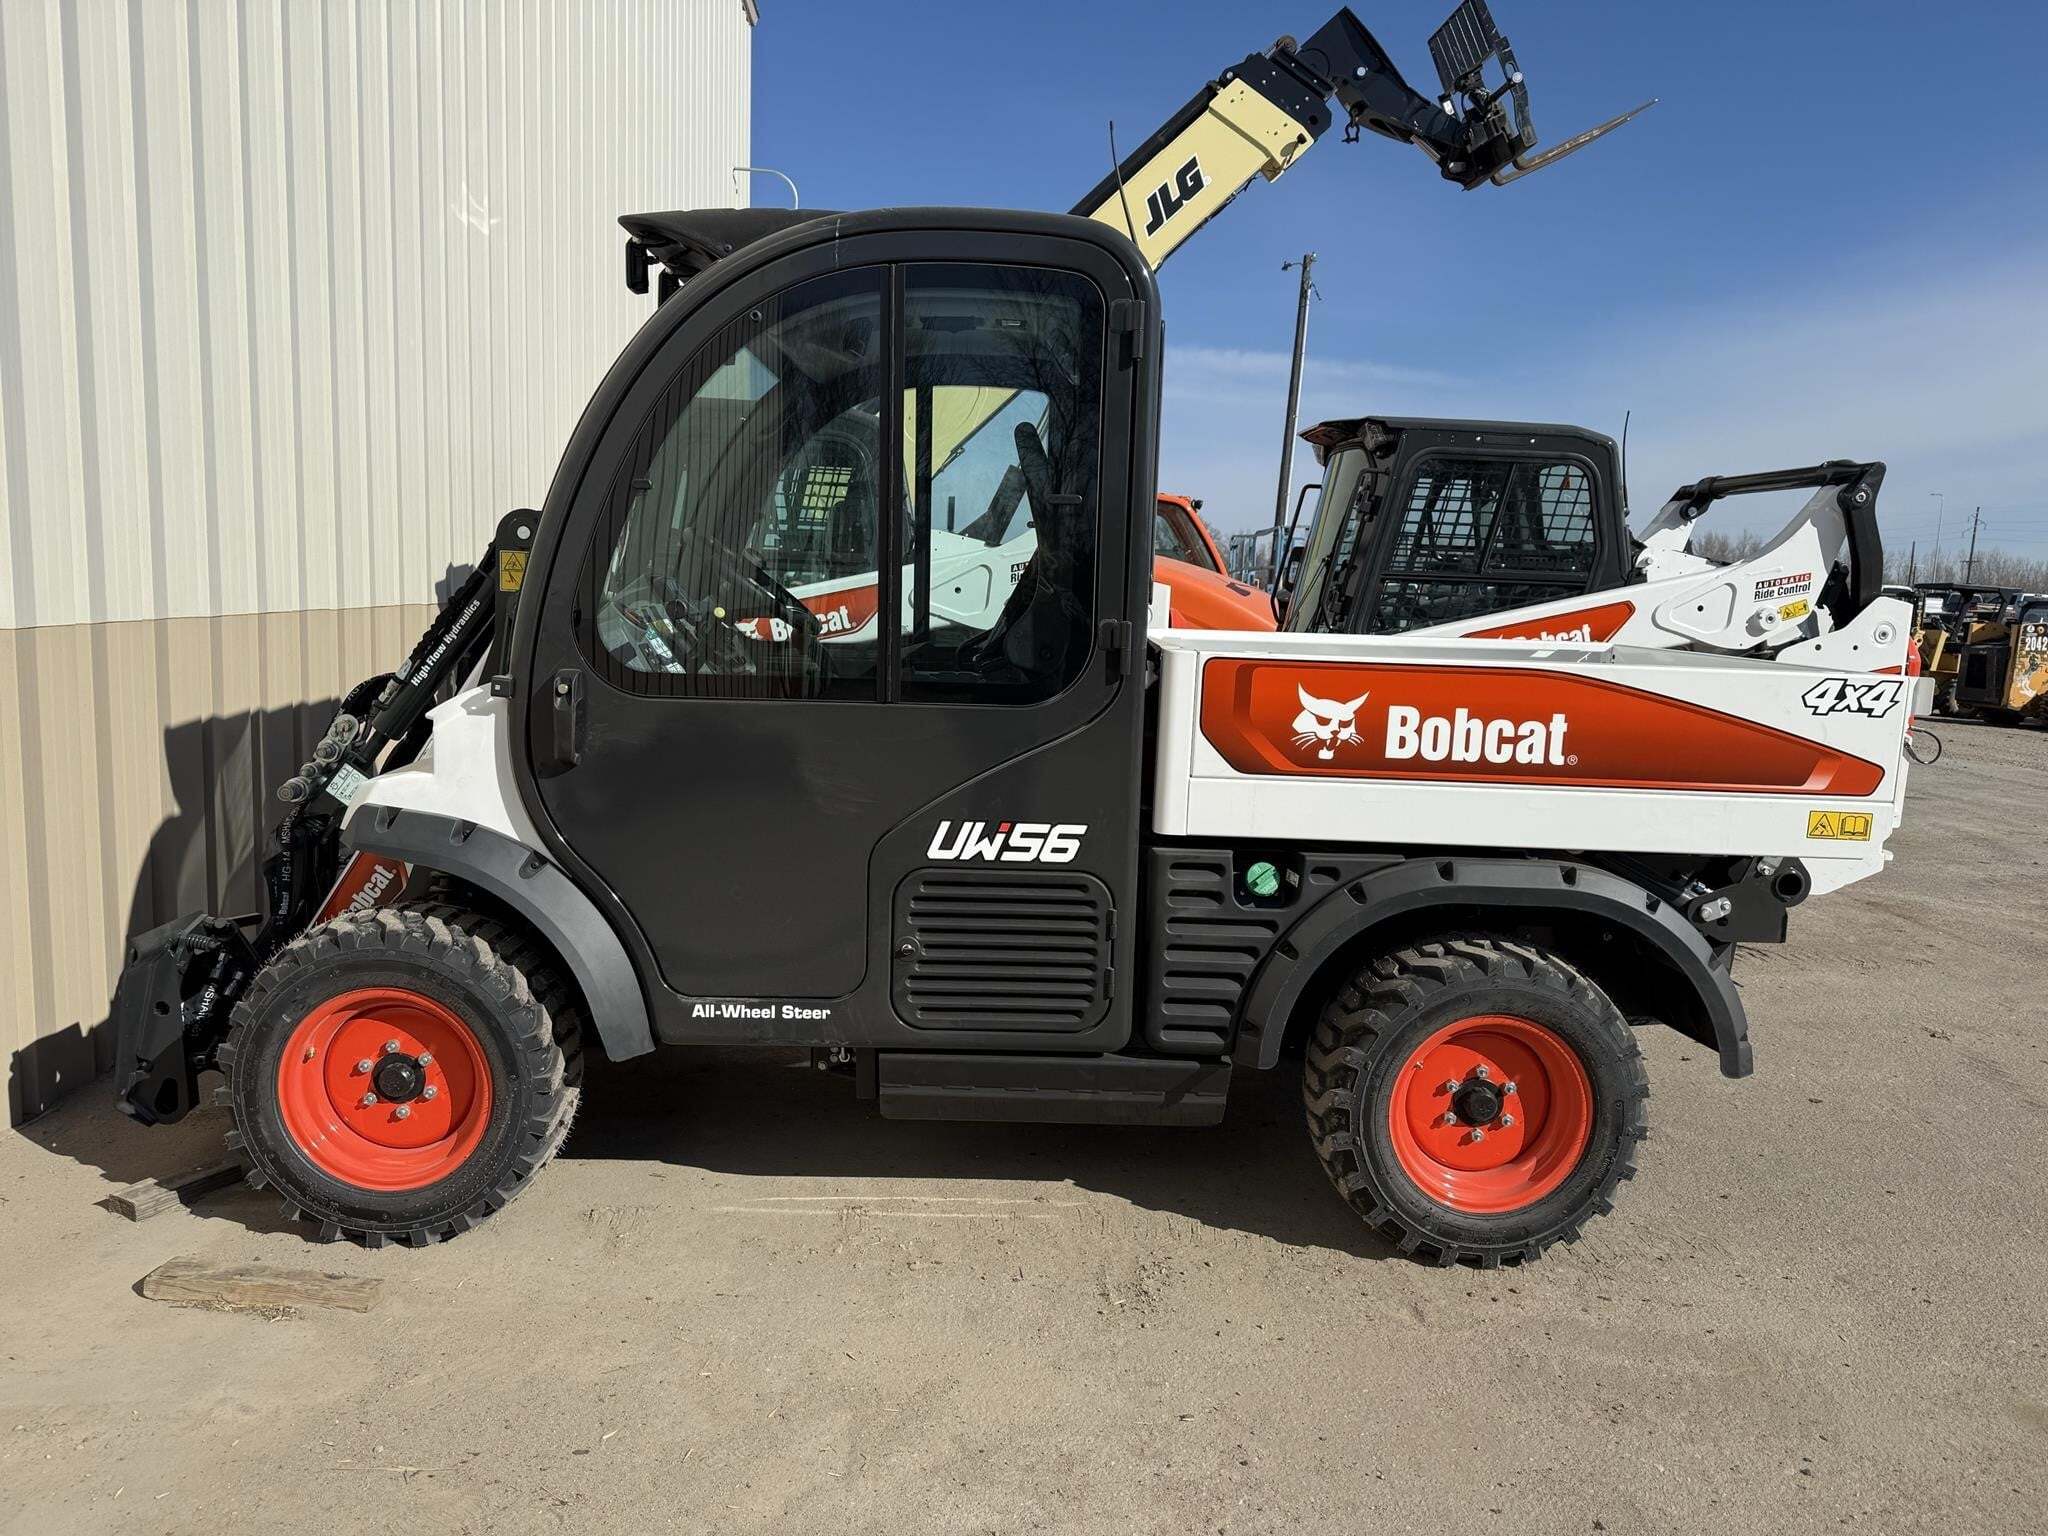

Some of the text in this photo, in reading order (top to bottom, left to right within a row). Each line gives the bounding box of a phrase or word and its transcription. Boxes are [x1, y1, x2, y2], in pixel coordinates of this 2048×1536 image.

[1145, 155, 1205, 237] JLG
[1754, 582, 1811, 600] Ride Control
[1756, 574, 1810, 588] AUTOMATIC
[410, 599, 480, 686] High Flow Hydraulics
[1801, 678, 1904, 718] 4x4
[1385, 705, 1568, 766] Bobcat
[691, 1003, 831, 1020] All-Wheel Steer
